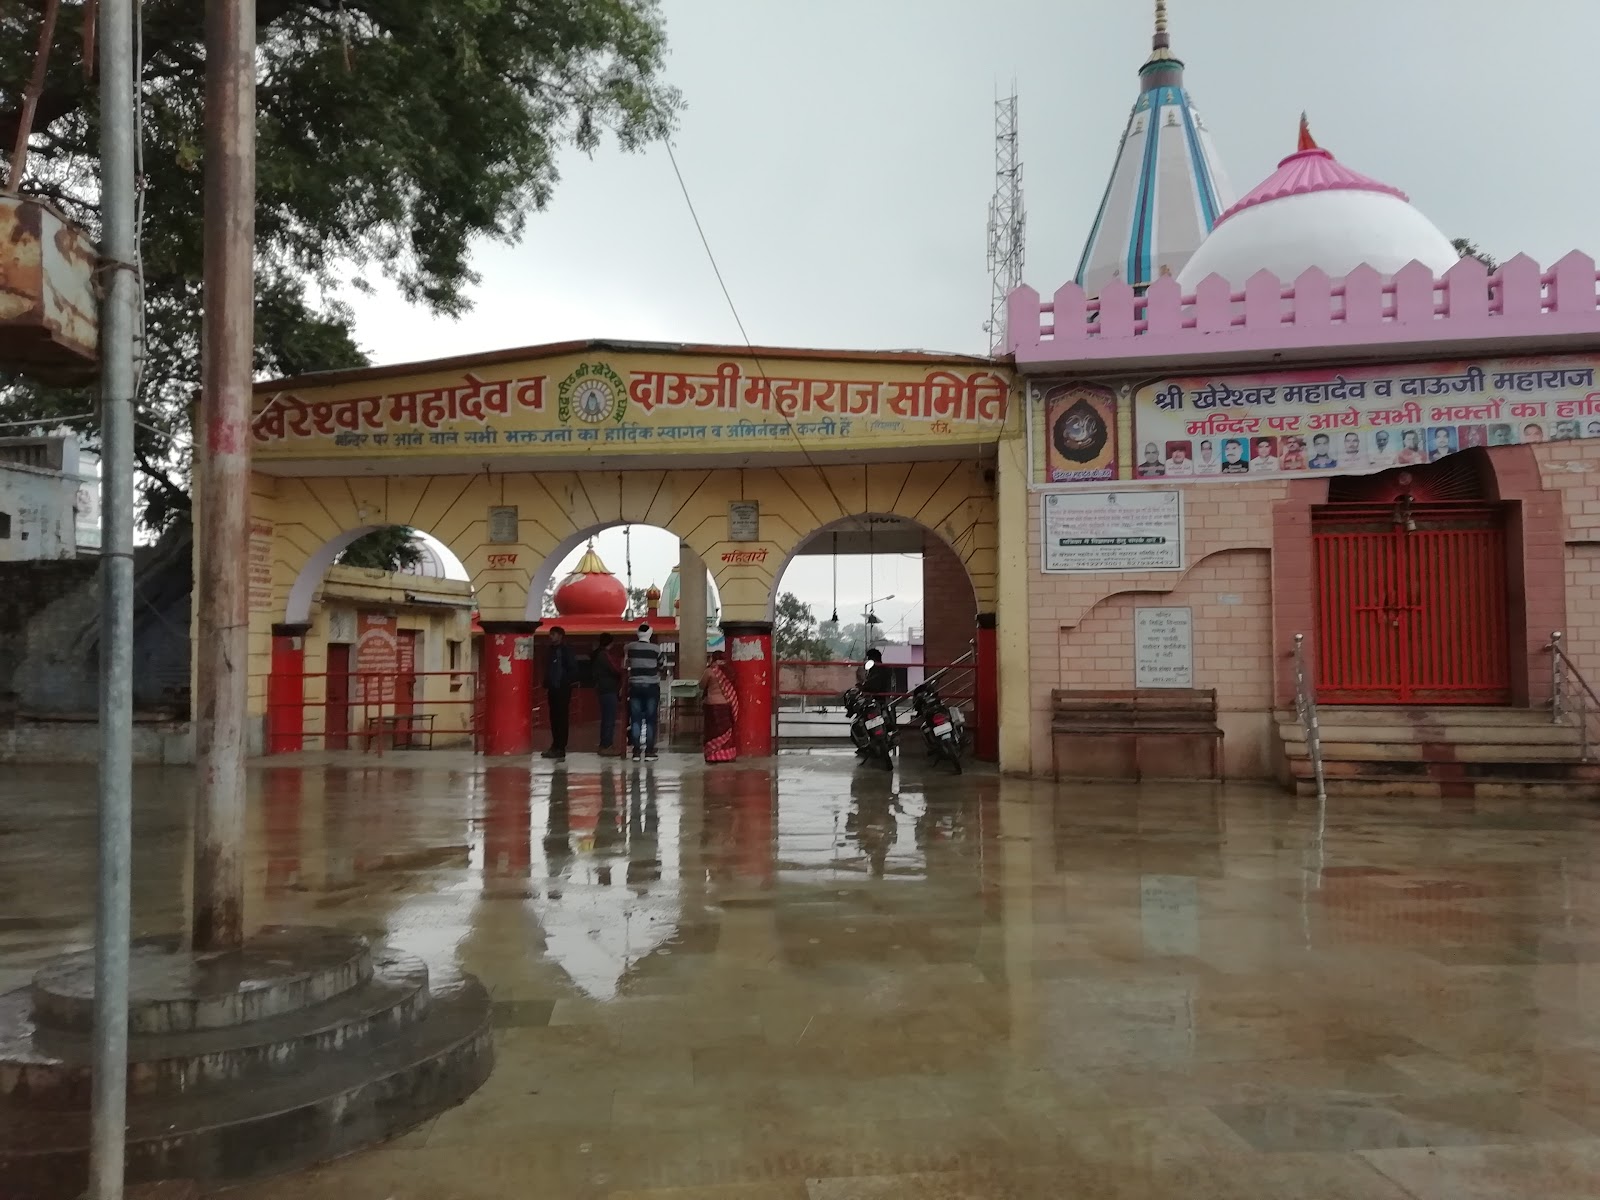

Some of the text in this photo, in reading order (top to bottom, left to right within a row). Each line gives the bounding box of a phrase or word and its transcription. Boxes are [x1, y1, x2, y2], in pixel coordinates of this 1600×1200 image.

[388, 372, 513, 428] महादेव
[517, 375, 547, 409] व
[629, 362, 742, 411] दाऊजी
[745, 376, 884, 418] महाराज
[886, 371, 1009, 420] समिति
[1155, 365, 1594, 410] श्री खेरेश्वर महादेव व दाऊजी महाराज
[577, 429, 600, 441] का
[657, 425, 708, 440] स्वागत
[1186, 412, 1261, 436] मन्दिर
[1267, 415, 1301, 430] पर
[1307, 406, 1361, 430] आये
[1367, 402, 1422, 426] सभी
[1431, 397, 1505, 422] भक्तों
[1511, 401, 1547, 418] का
